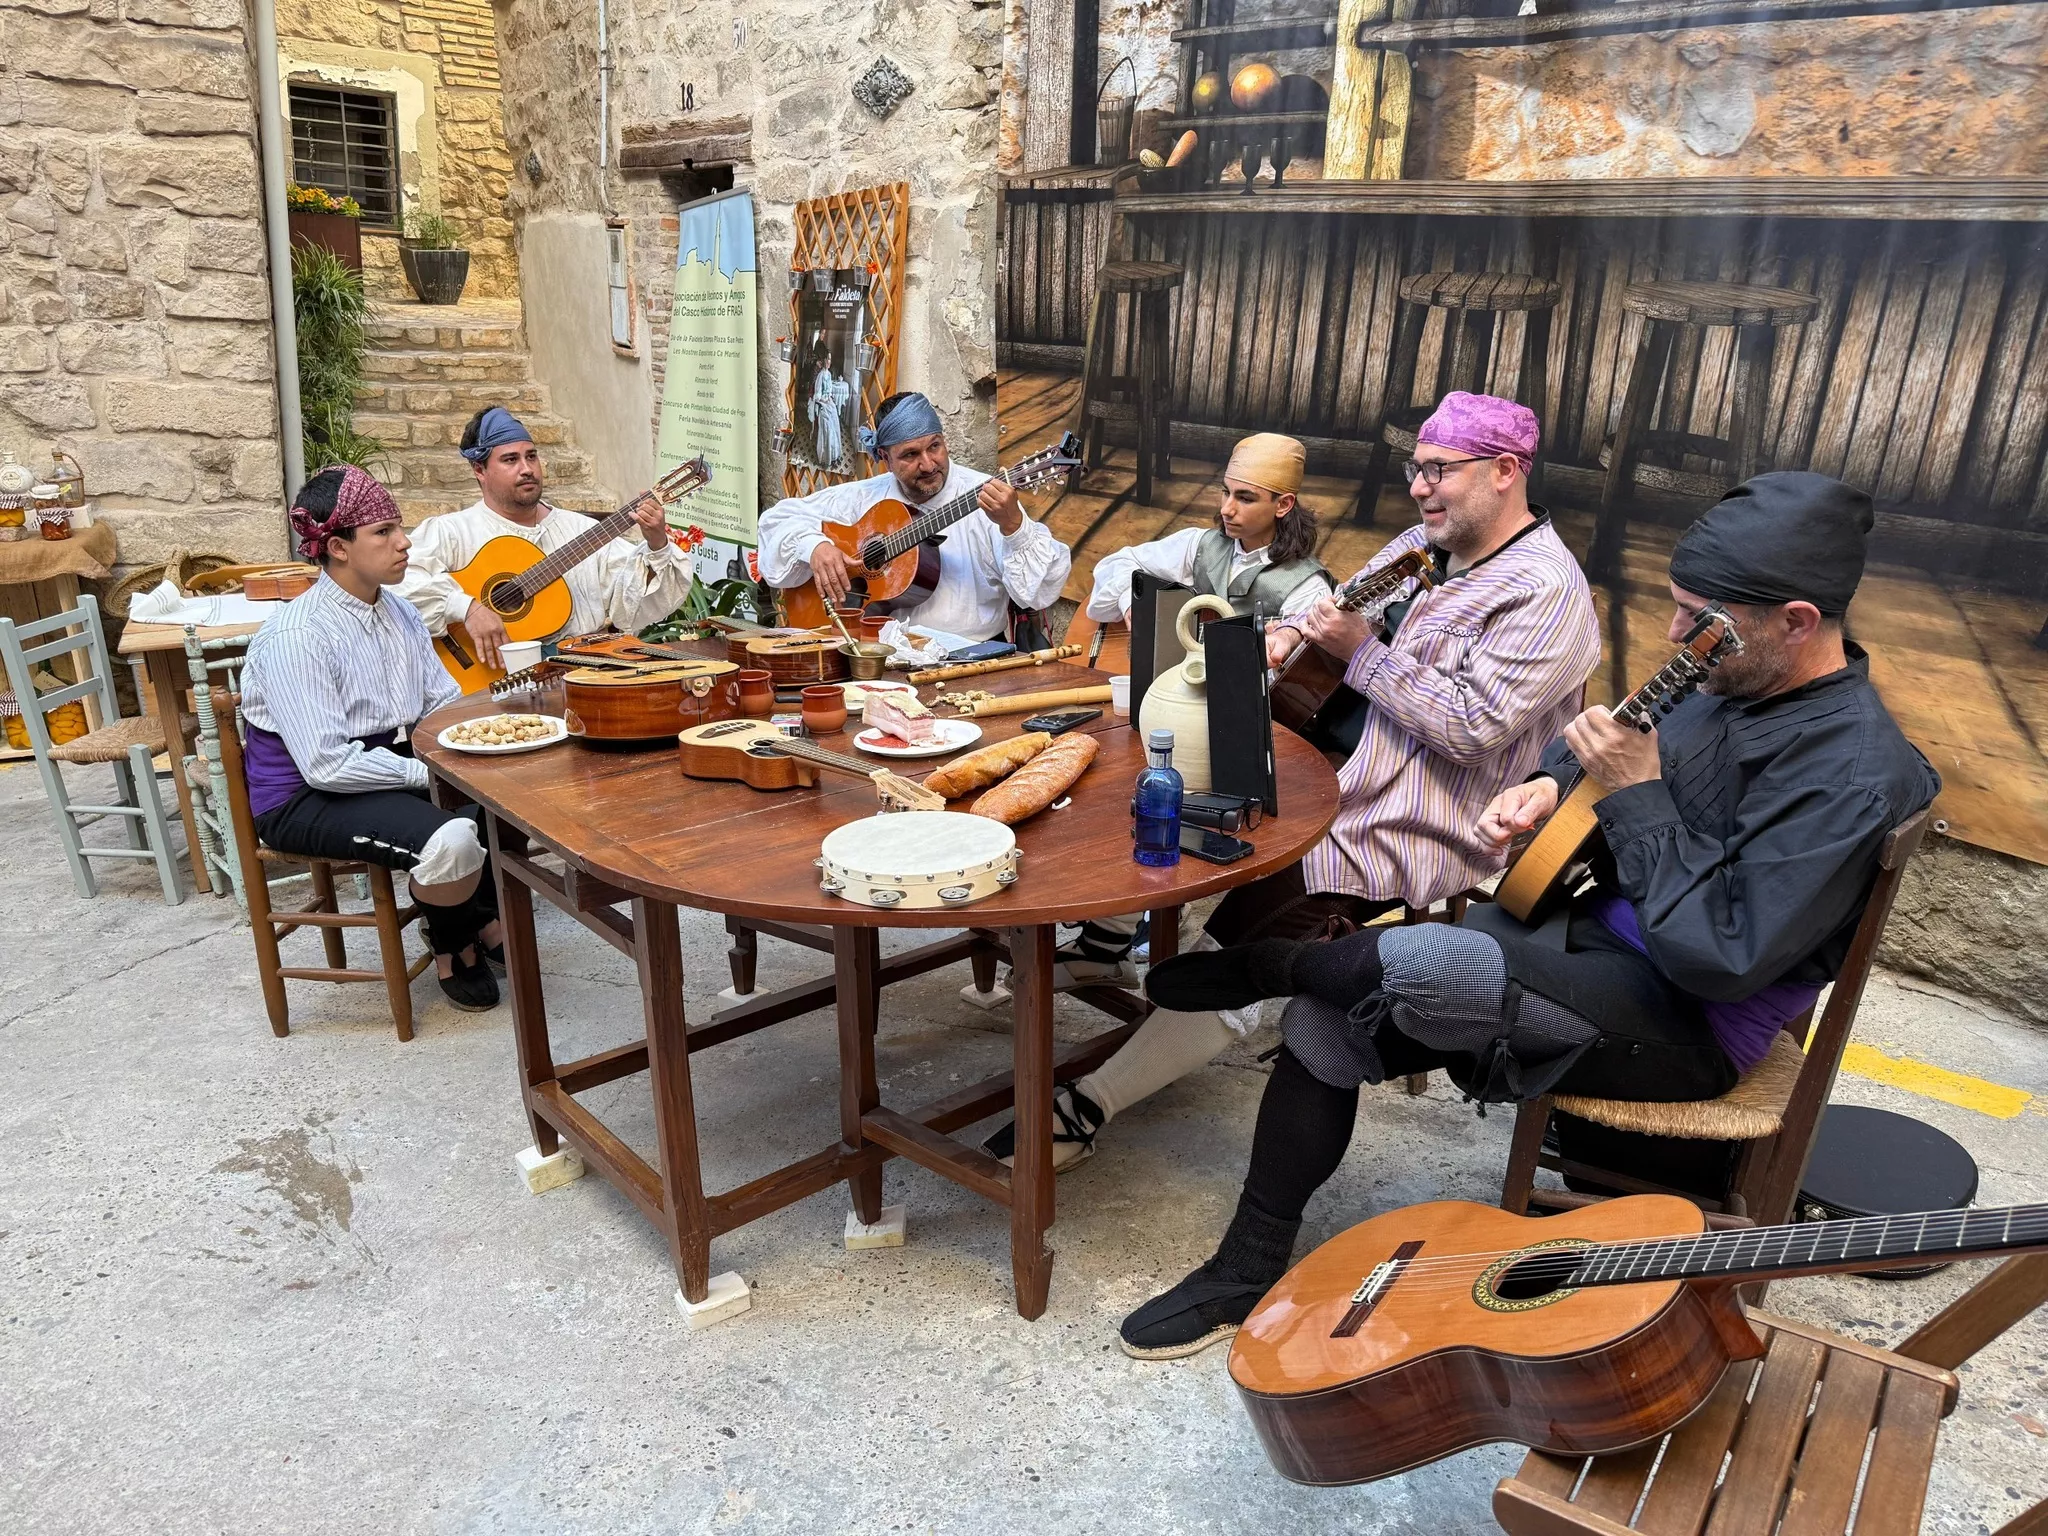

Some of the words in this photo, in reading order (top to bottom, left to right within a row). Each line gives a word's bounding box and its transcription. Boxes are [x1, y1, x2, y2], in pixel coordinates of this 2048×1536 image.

[680, 82, 693, 111] 18
[724, 292, 728, 303] y
[729, 289, 746, 302] Amigos
[681, 306, 700, 317] Casco
[717, 305, 726, 316] de
[727, 305, 744, 316] FRAGA
[663, 400, 682, 408] Concurso
[684, 402, 690, 410] de
[713, 406, 729, 415] Ciudad
[679, 415, 691, 423] Feria
[715, 460, 720, 468] de
[732, 491, 739, 499] de
[675, 511, 686, 519] para
[697, 543, 718, 561] Gusta
[696, 561, 702, 574] el
